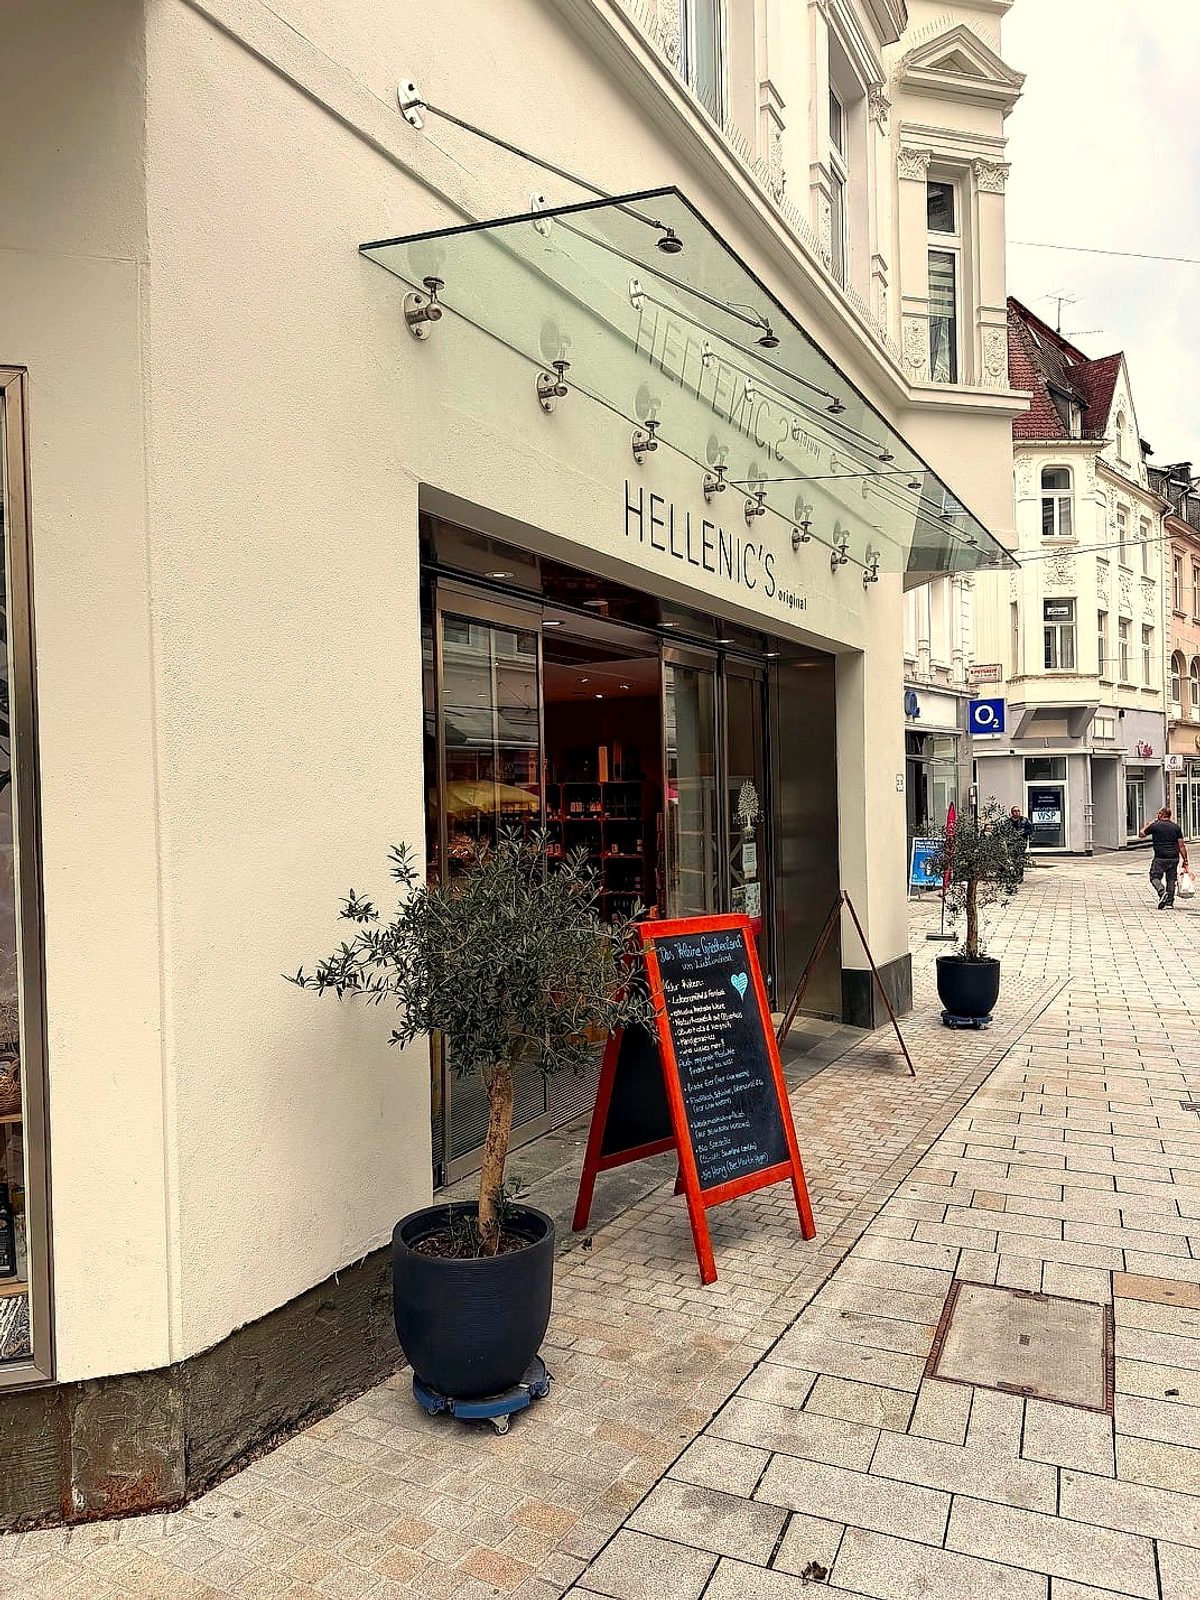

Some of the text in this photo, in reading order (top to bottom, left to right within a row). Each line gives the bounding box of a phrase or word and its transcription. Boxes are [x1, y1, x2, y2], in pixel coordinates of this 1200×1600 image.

[624, 479, 807, 611] HELLENIC'S original
[1037, 811, 1056, 821] WSP
